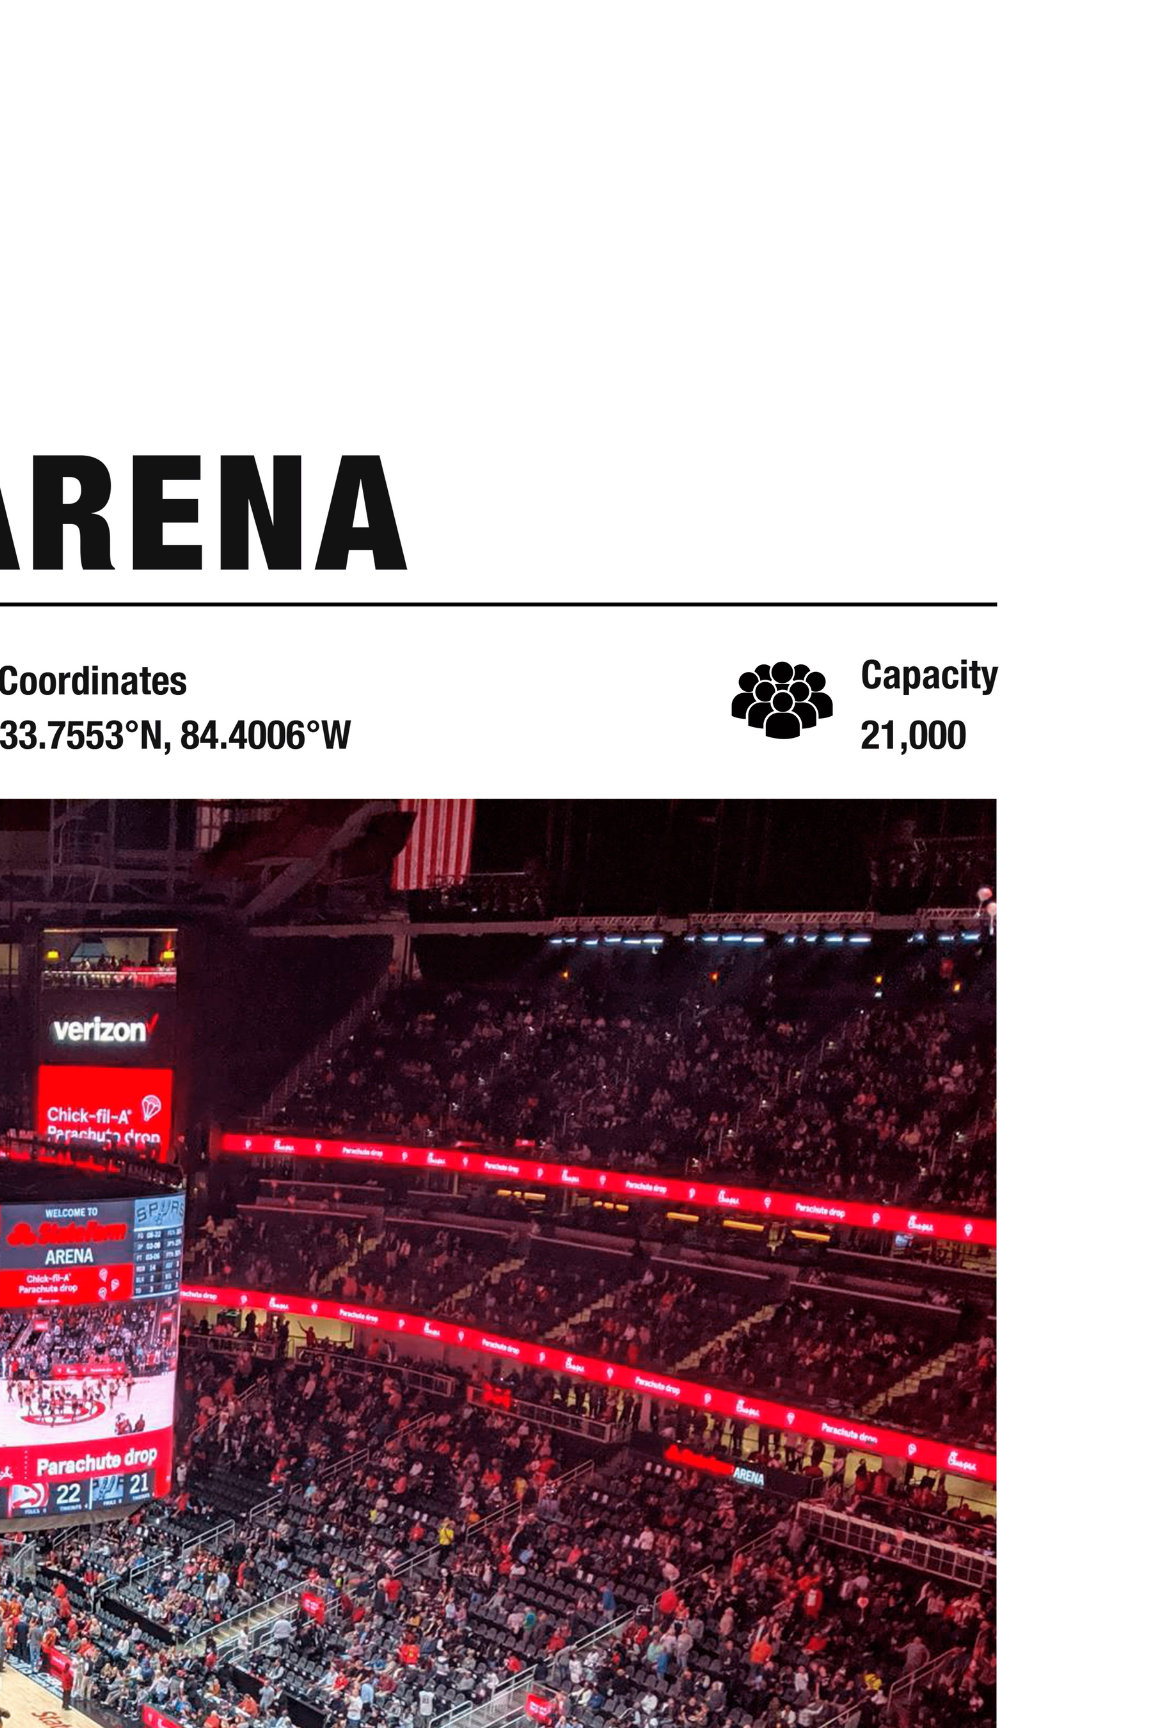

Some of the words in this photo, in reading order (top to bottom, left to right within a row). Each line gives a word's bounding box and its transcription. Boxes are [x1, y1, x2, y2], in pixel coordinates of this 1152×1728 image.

[53, 1016, 146, 1041] verizon
[45, 1207, 86, 1219] WELCOME
[87, 1206, 98, 1217] TO
[795, 1202, 828, 1216] Parachute
[828, 1207, 846, 1219] drop
[45, 1247, 94, 1266] ARENA
[18, 1284, 58, 1294] Parachute
[59, 1283, 78, 1294] drop
[821, 1421, 858, 1440] Parachute
[36, 1452, 122, 1477] Parachute
[124, 1447, 158, 1467] drop
[129, 1472, 149, 1495] 21
[733, 1466, 765, 1487] ARENA
[56, 1483, 81, 1505] 22
